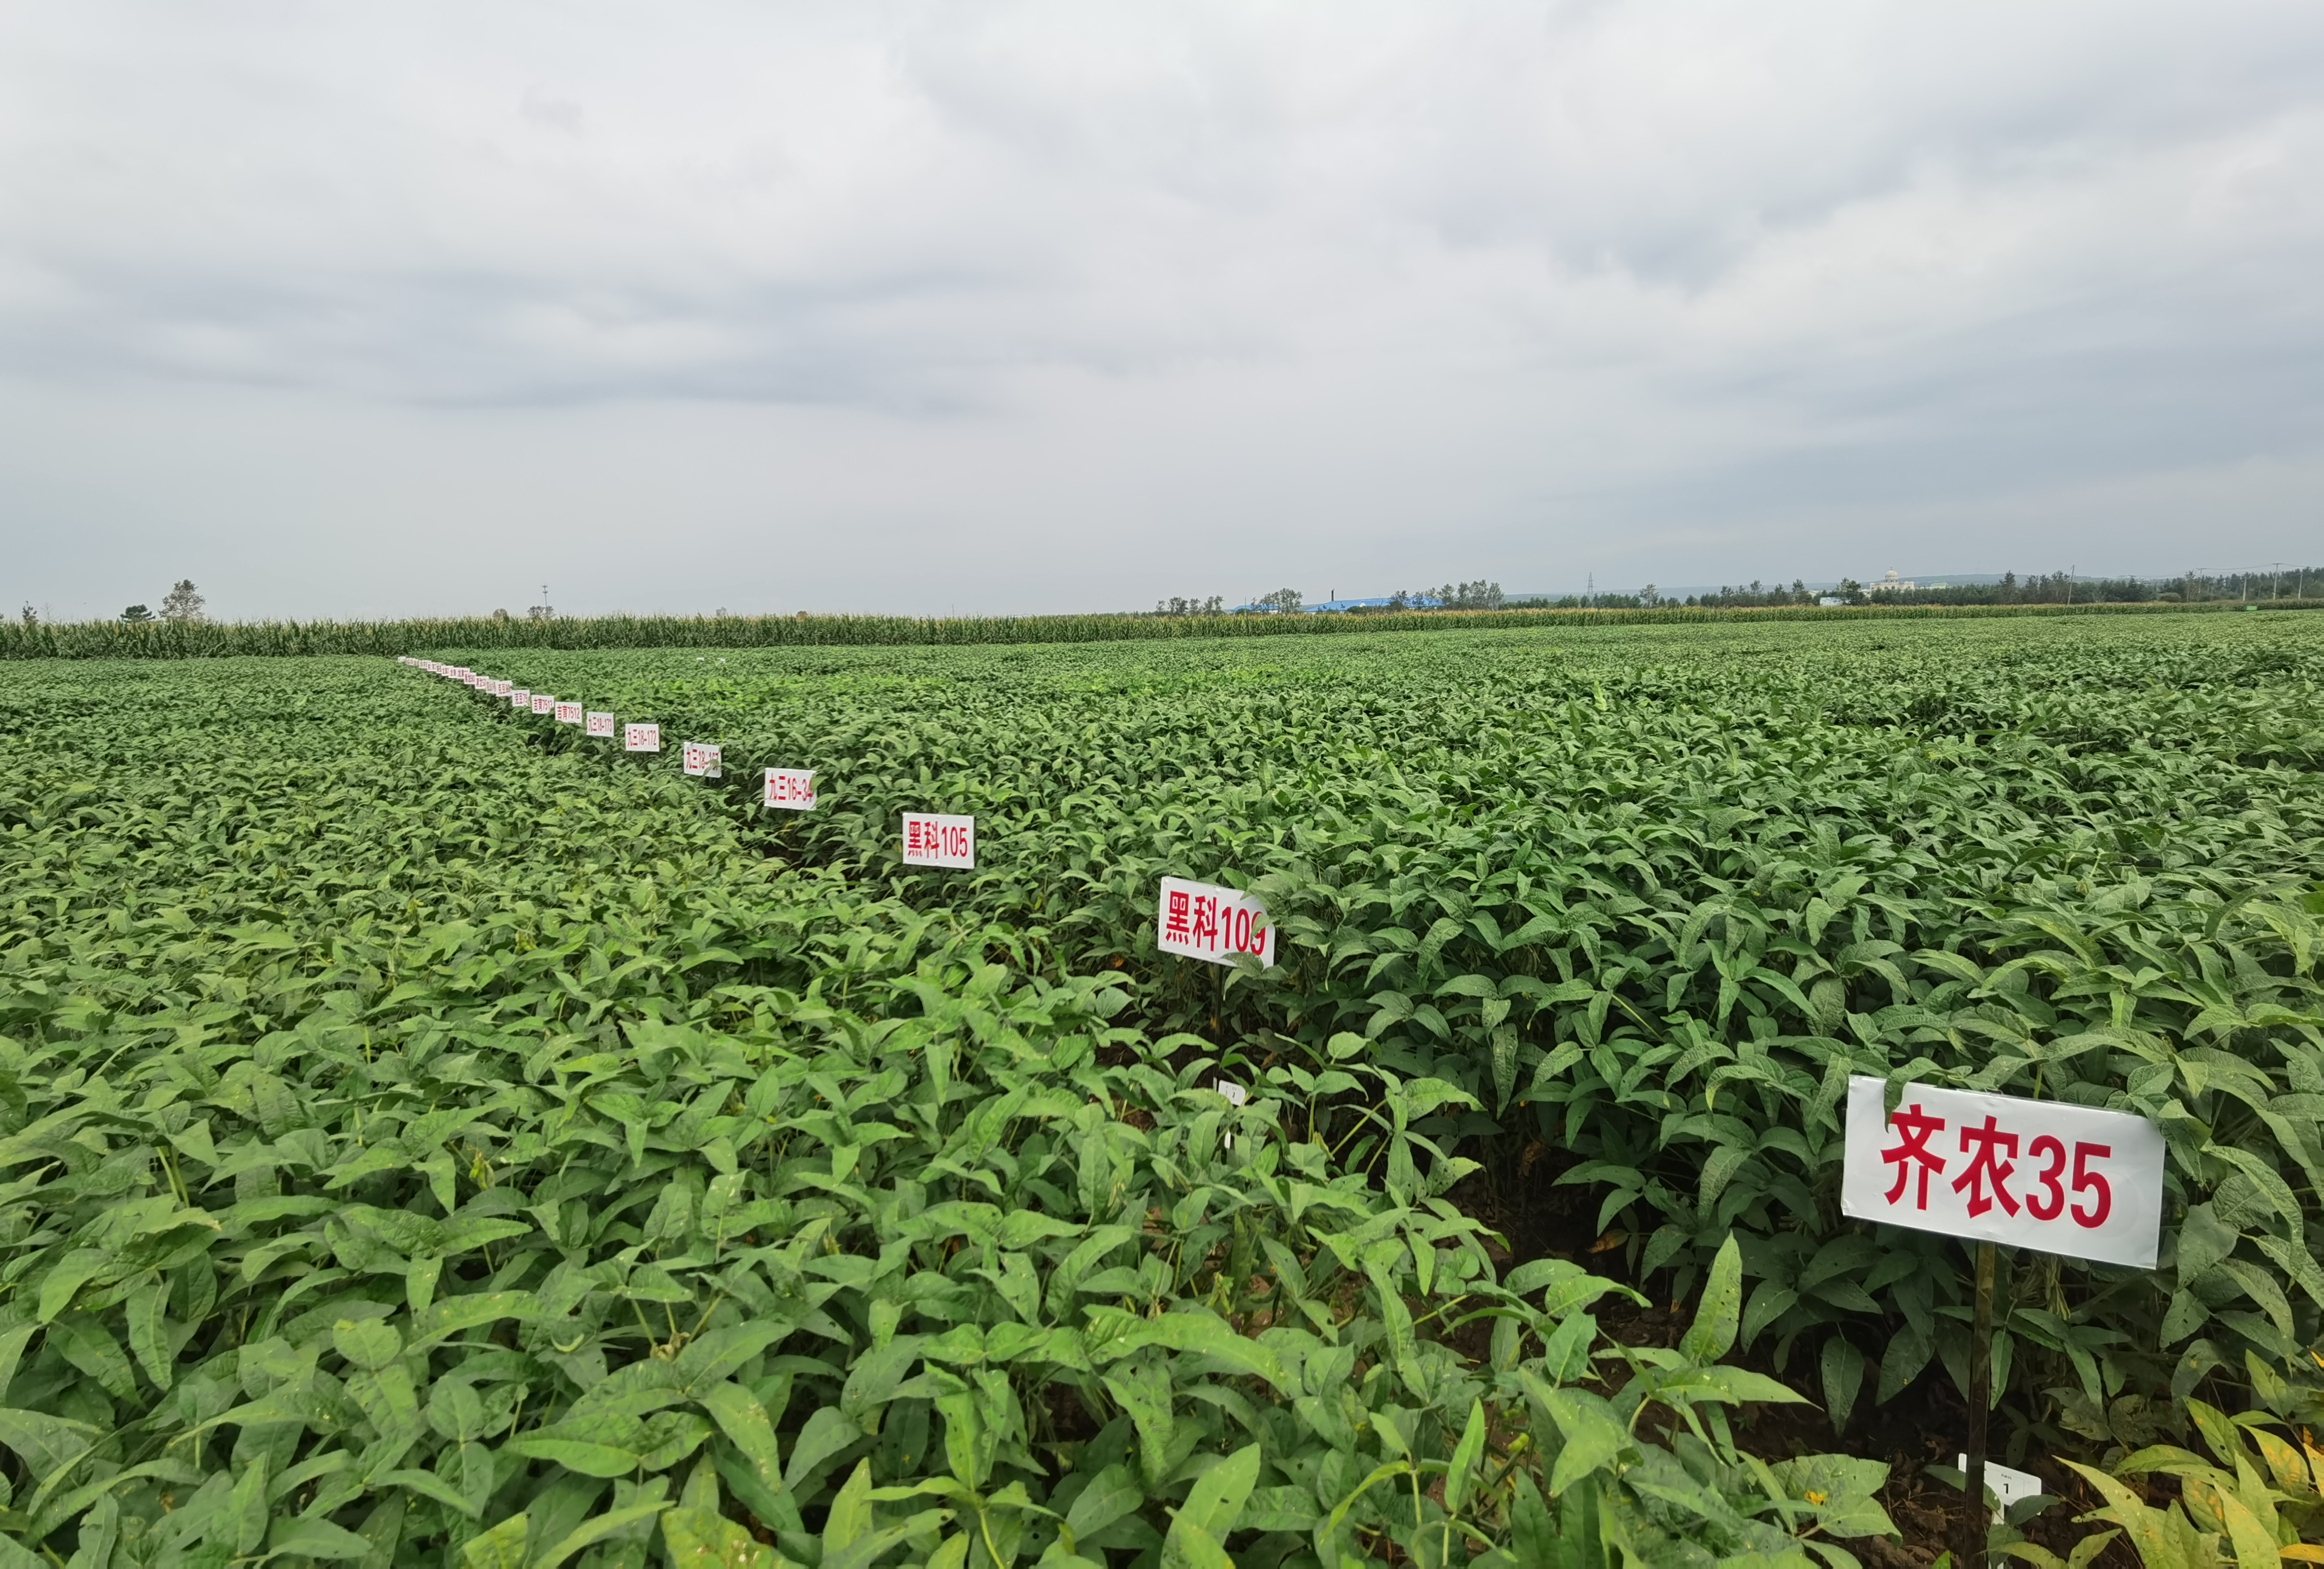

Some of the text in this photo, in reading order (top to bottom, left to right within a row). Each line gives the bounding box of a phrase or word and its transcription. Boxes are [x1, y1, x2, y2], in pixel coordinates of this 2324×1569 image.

[588, 715, 612, 732] 九三18-173
[628, 728, 657, 747] 九三18-172
[769, 772, 813, 802] 九三16-34
[908, 821, 968, 858] 黑科105
[1166, 890, 1266, 956] 黑科109
[1880, 1104, 2112, 1229] 齐农35
[2003, 1483, 2009, 1494] 1
